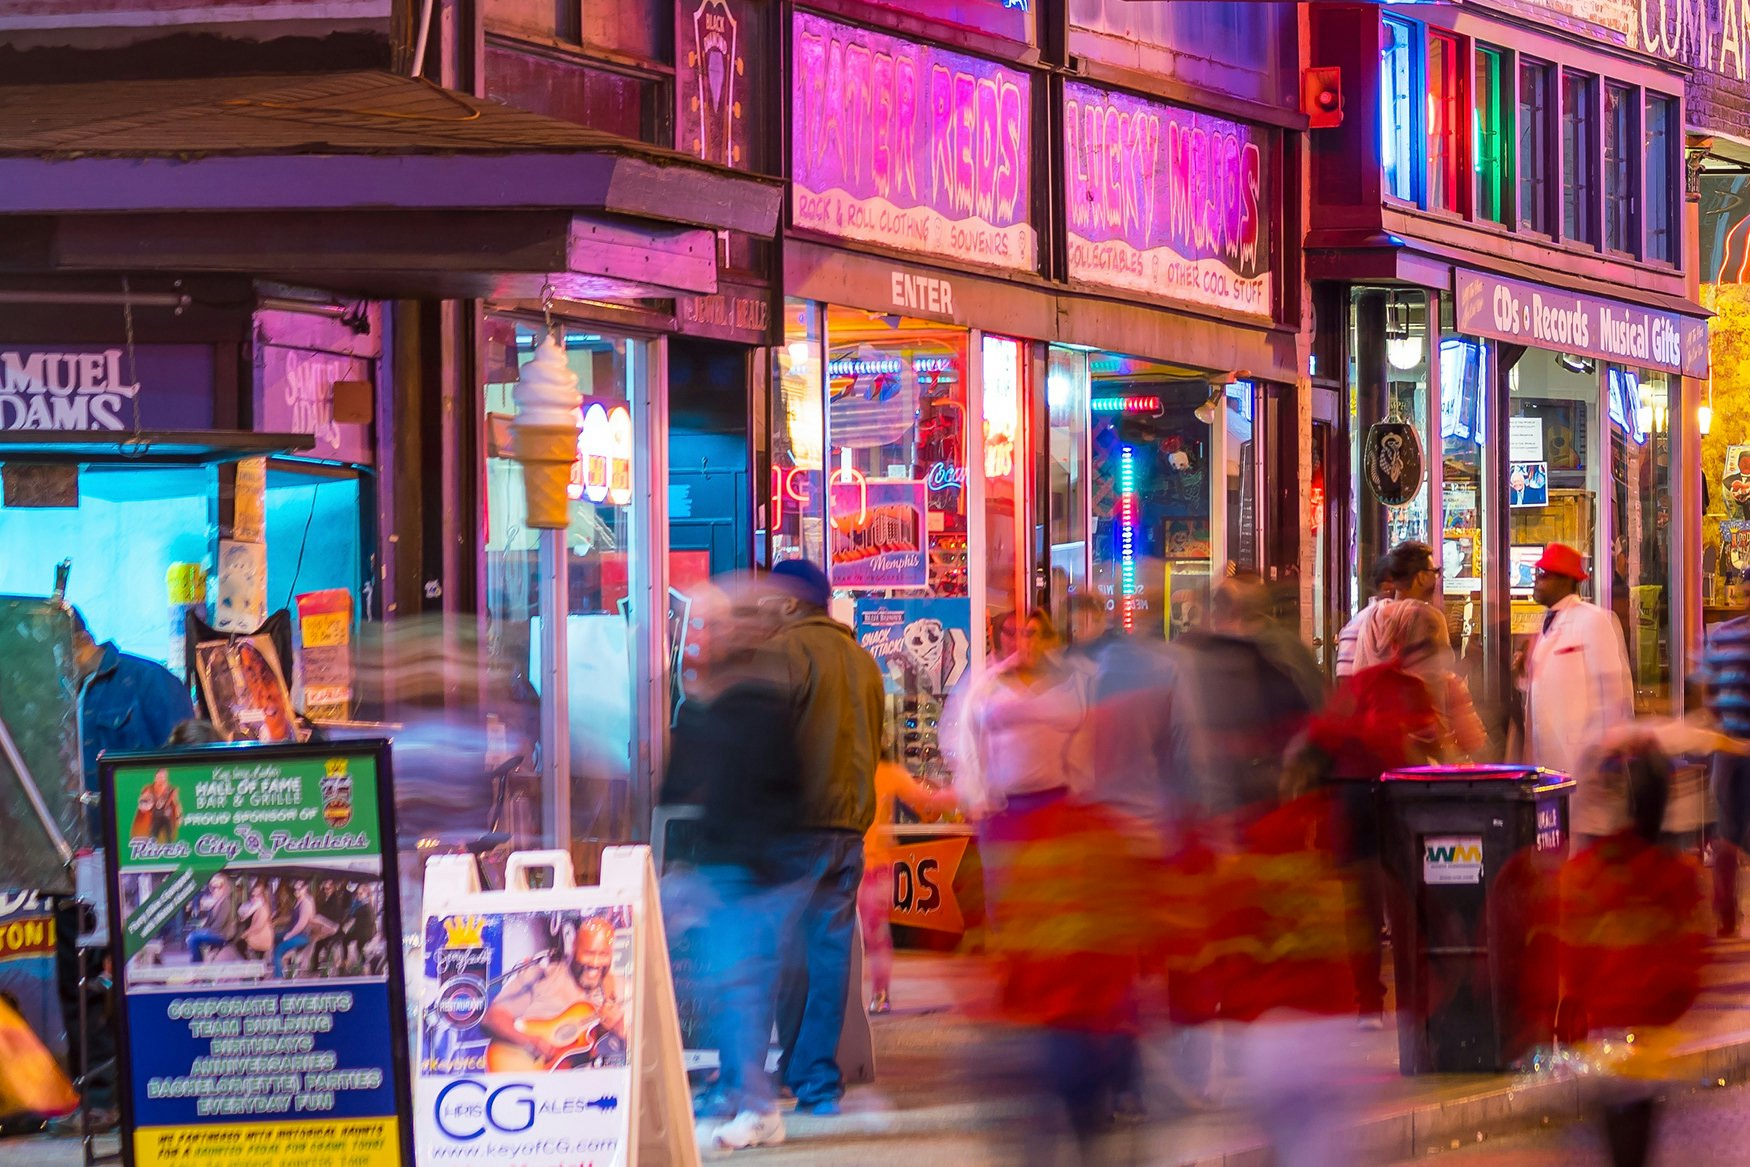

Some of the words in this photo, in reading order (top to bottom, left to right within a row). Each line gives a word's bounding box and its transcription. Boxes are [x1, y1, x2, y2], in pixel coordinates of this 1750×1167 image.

[706, 14, 724, 33] BLACK
[800, 31, 917, 201] TATER
[1066, 100, 1160, 249] LUCKY
[1168, 120, 1261, 274] MOJOS
[800, 195, 830, 221] ROCK
[848, 206, 874, 230] ROLL
[880, 210, 930, 242] CLOTHING
[1069, 241, 1144, 277] COLLECTABLES
[1168, 263, 1201, 289] OTHER
[1203, 271, 1229, 297] COOL
[1234, 278, 1264, 304] STUFF
[891, 271, 953, 315] ENTER
[1493, 284, 1520, 334] CDs
[1532, 293, 1589, 348] Records
[1600, 305, 1649, 360] Musical
[1652, 316, 1681, 367] Gifts
[0, 349, 140, 398] MUEL
[869, 552, 920, 572] Memphis
[861, 628, 891, 648] SNACK
[196, 781, 235, 797] HALL
[236, 779, 256, 795] OF
[260, 777, 301, 793] FAME
[196, 794, 227, 810] BAR
[249, 791, 302, 807] GRILLE
[184, 810, 232, 826] PROUD
[232, 809, 298, 825] SPONSOR
[299, 807, 319, 821] OF
[129, 835, 192, 861] River
[195, 833, 242, 861] City
[269, 829, 371, 853] Pedalers
[1428, 845, 1481, 863] WM
[168, 995, 279, 1020] CORPORATE
[280, 991, 354, 1014] EVENTS
[189, 1017, 242, 1038] TEAM
[244, 1012, 334, 1035] BUILDING
[210, 1033, 315, 1056] BIRTHDAYS
[190, 1050, 338, 1077] ANNIVERSARIES
[147, 1074, 301, 1099] BACHELOR(ETTE)
[304, 1068, 383, 1091] PARTIES
[197, 1094, 293, 1116] EVERYDAY
[294, 1091, 336, 1112] FUN
